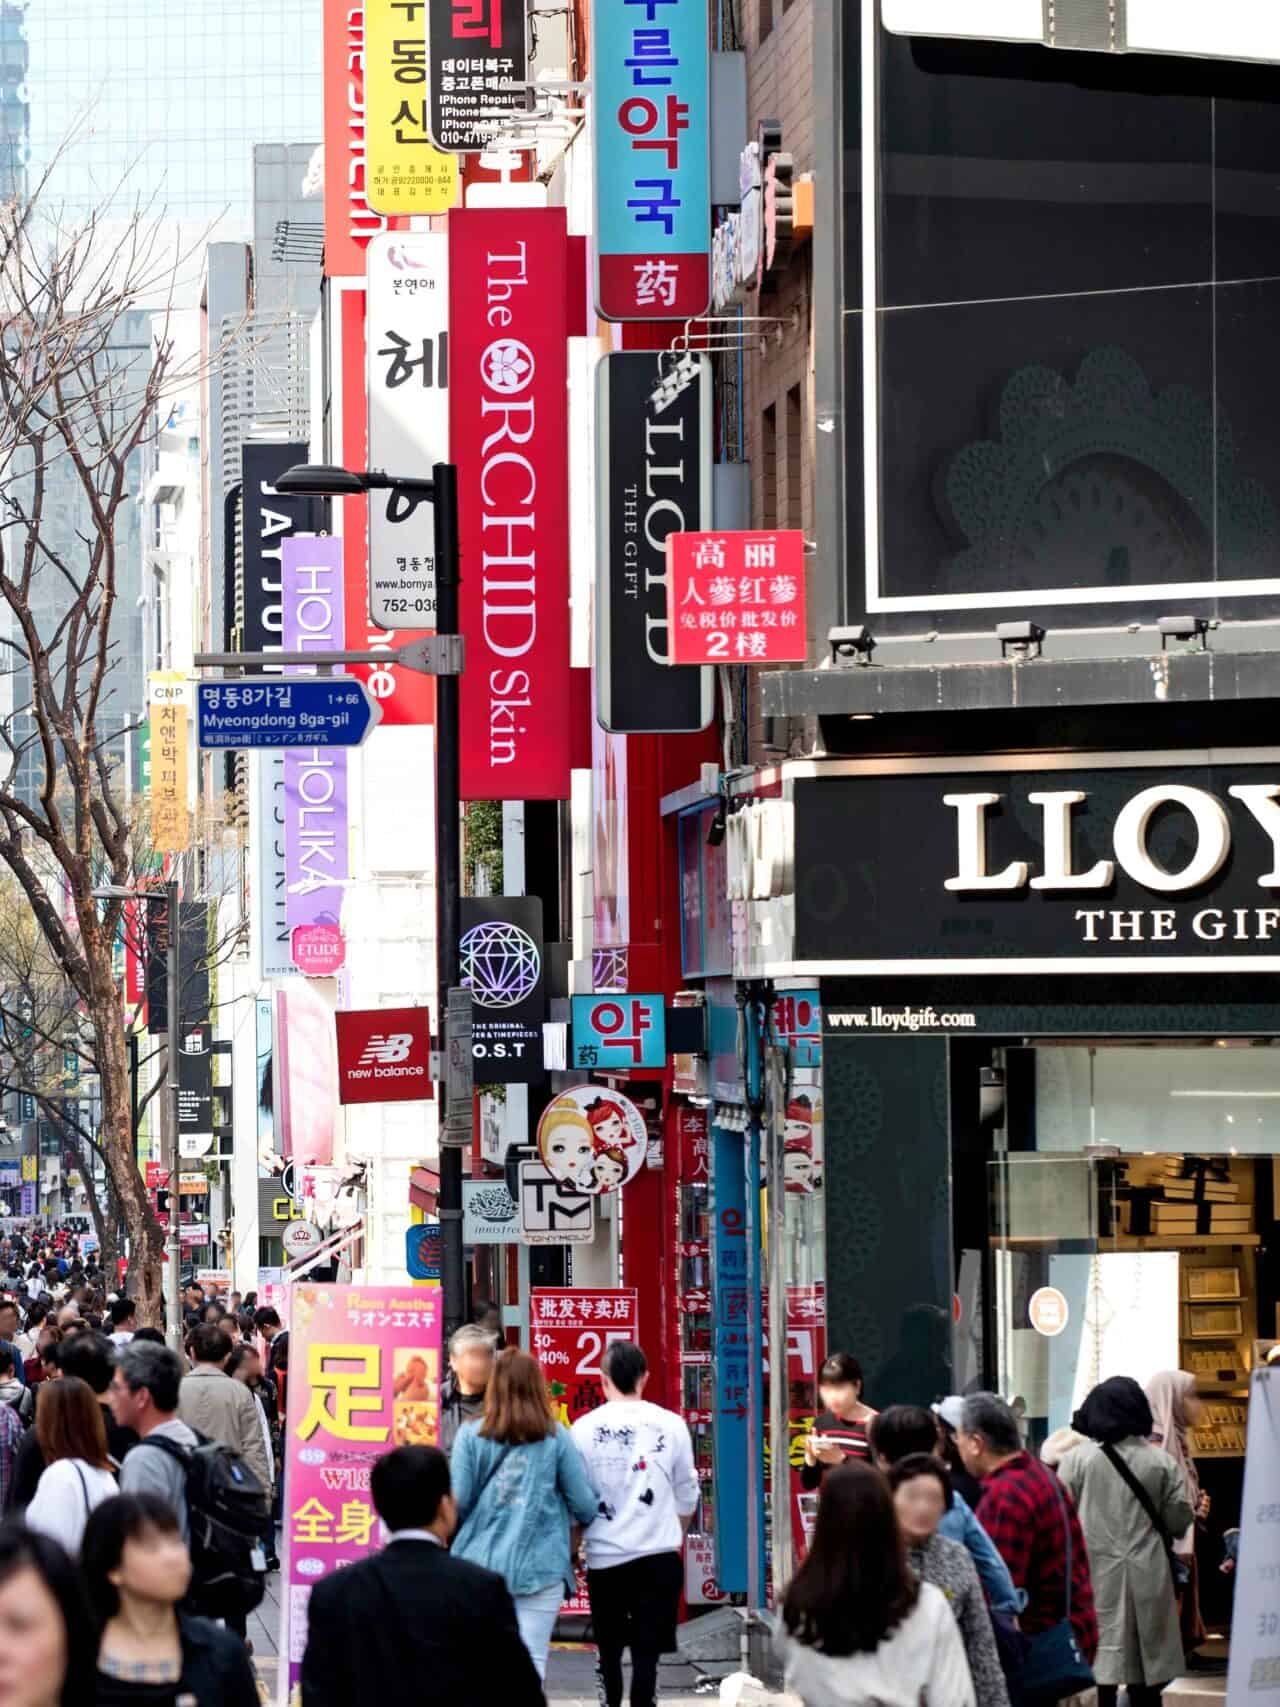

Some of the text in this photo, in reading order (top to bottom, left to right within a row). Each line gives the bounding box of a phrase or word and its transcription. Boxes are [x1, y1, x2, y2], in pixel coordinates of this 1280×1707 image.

[486, 240, 529, 328] The
[623, 484, 639, 600] THE GIFT
[383, 599, 438, 613] 752-036
[154, 687, 183, 698] CNP
[202, 687, 293, 710] 명동8가길
[202, 713, 350, 729] Myeongdong 8ga-gil
[489, 669, 533, 768] Skin
[1075, 909, 1178, 942] THE
[297, 943, 341, 956] ETUDE
[590, 1000, 651, 1064] 약
[348, 1065, 424, 1080] new balance
[295, 1343, 391, 1442] 足
[292, 1497, 377, 1546] 全身
